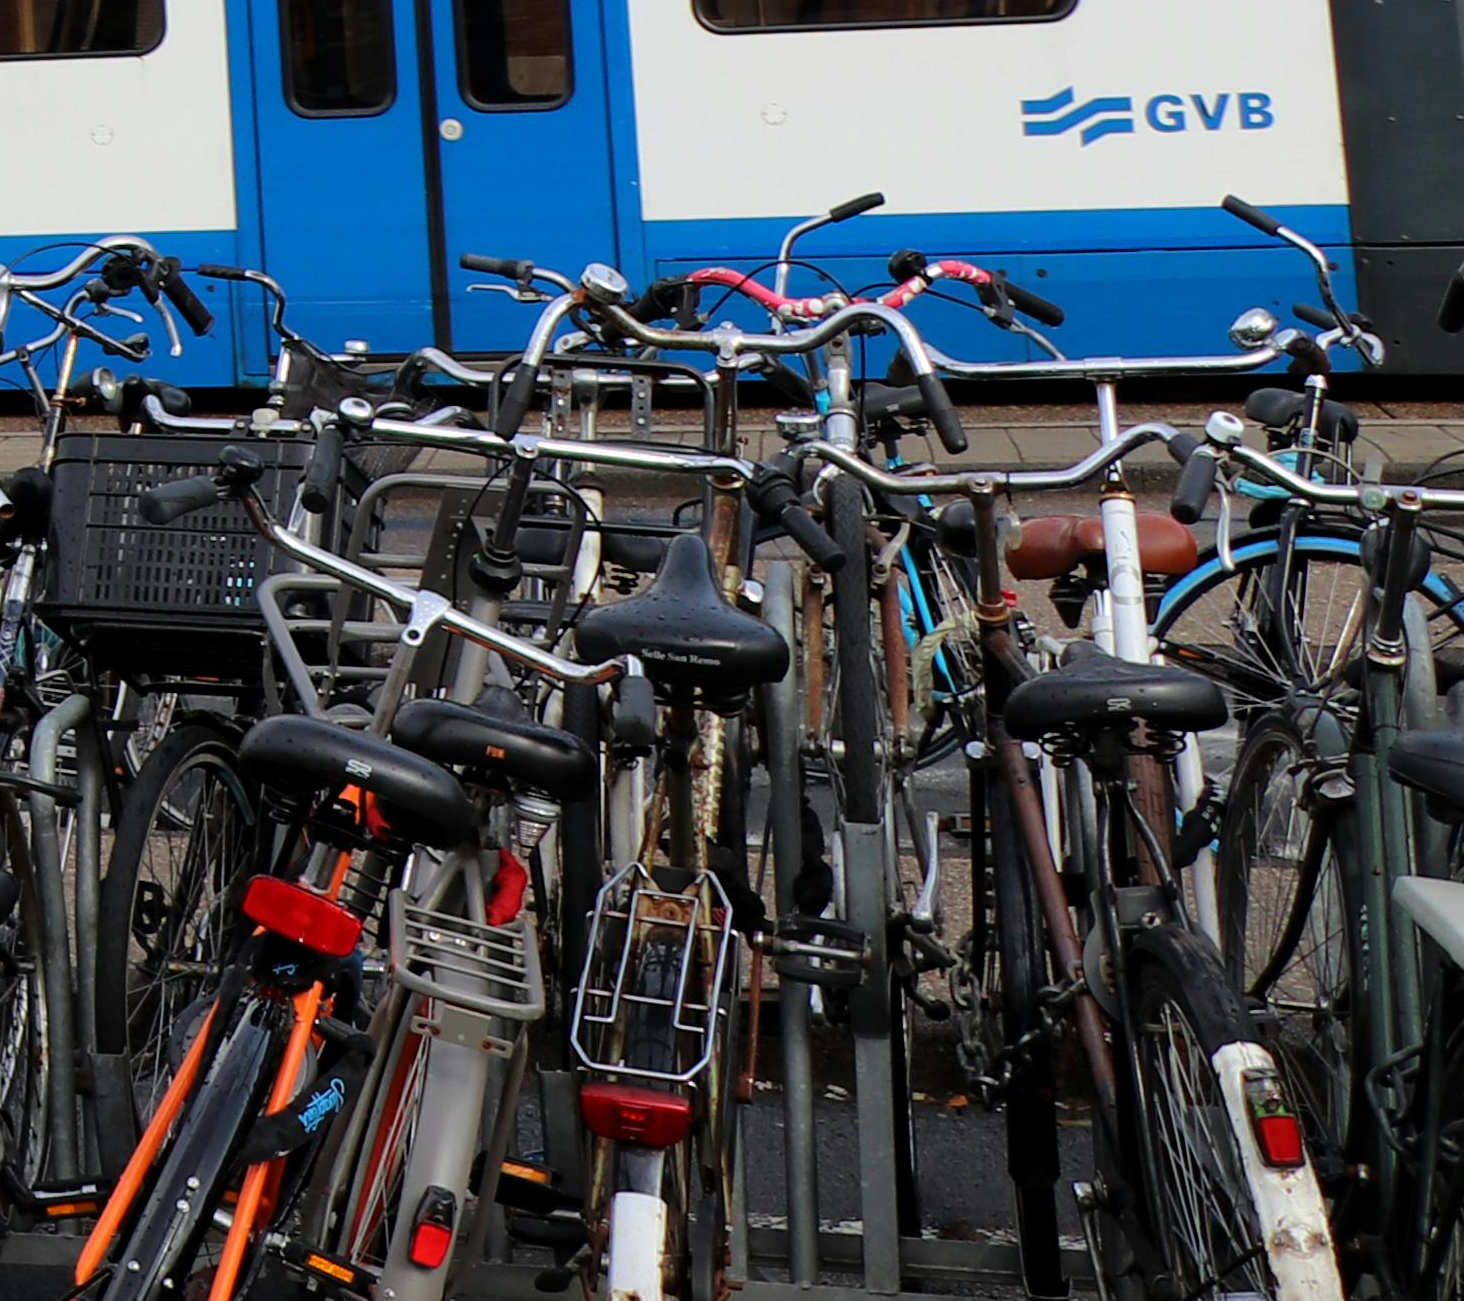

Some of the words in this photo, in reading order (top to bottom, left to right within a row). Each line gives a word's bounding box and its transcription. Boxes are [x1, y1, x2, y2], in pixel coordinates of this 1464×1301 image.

[1145, 91, 1276, 132] GVB
[641, 648, 666, 661] Selle
[667, 653, 687, 662] San
[689, 654, 721, 666] Remo
